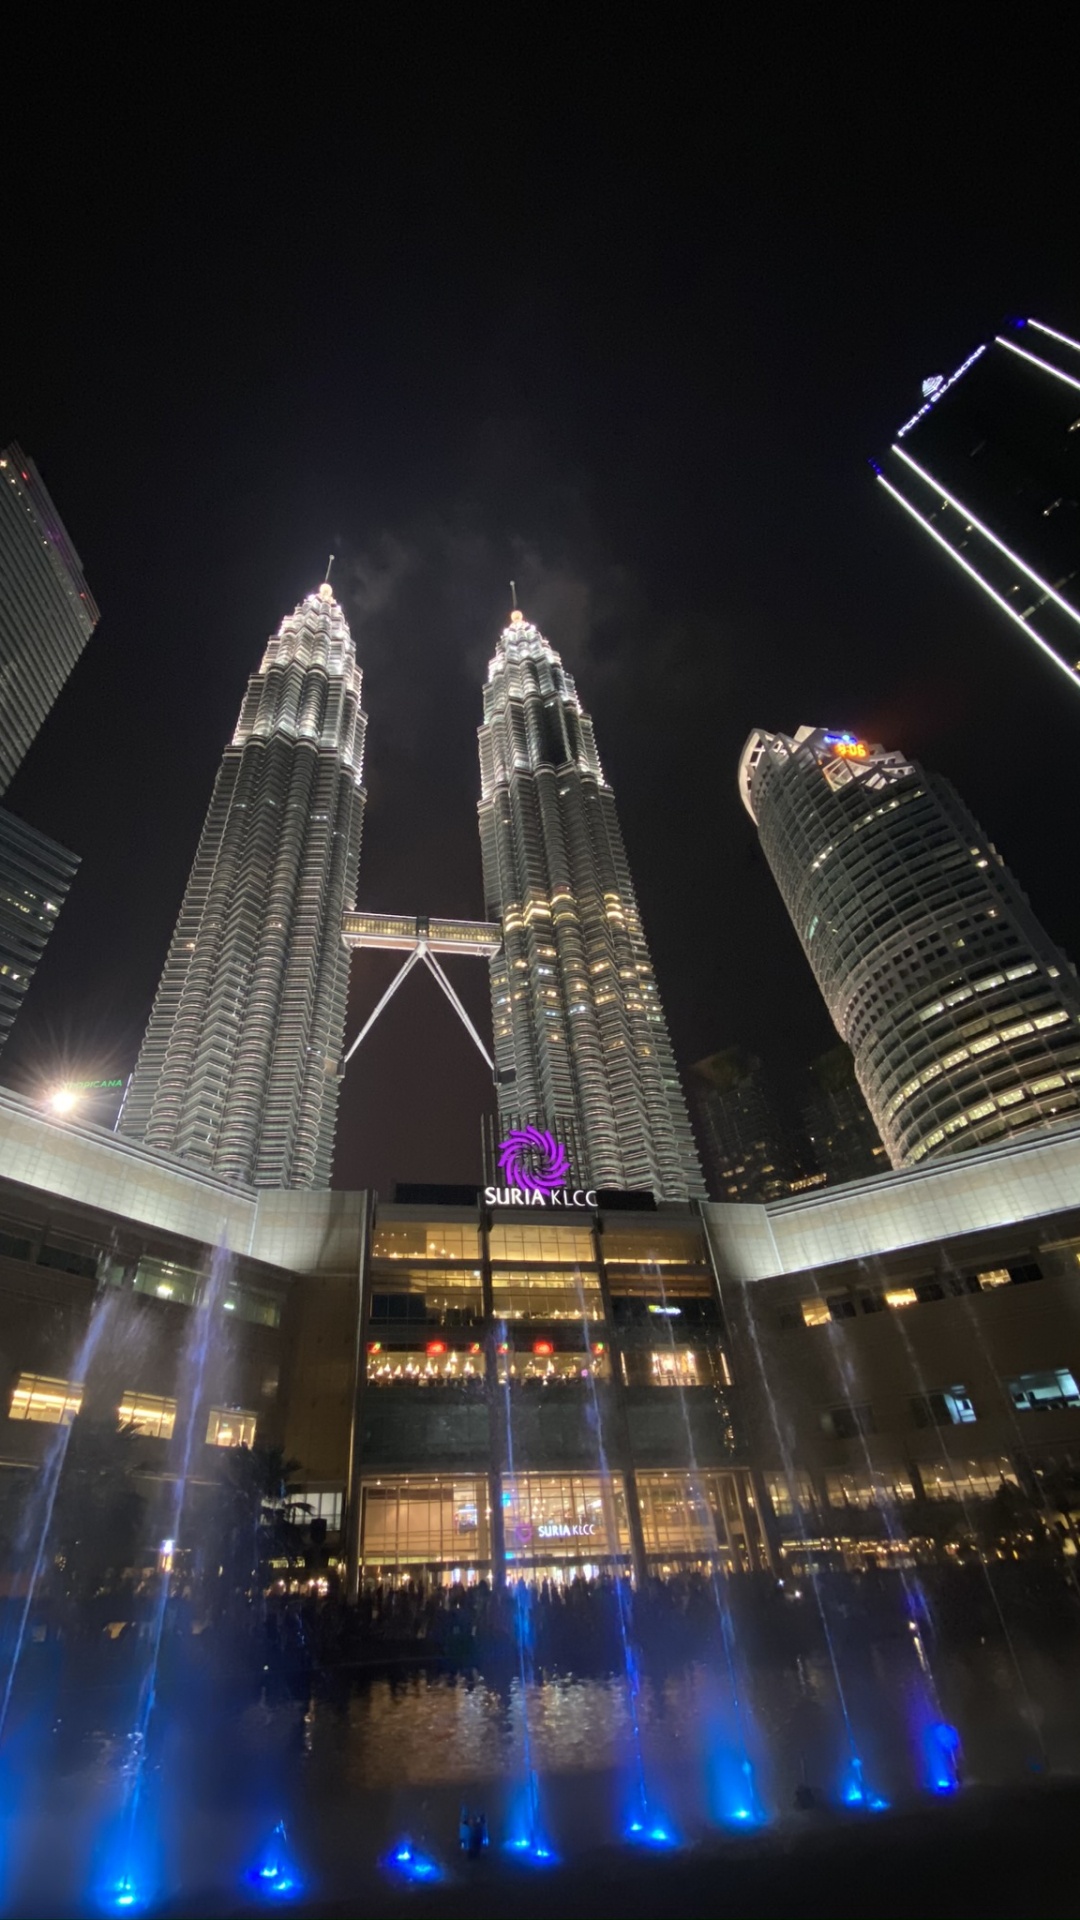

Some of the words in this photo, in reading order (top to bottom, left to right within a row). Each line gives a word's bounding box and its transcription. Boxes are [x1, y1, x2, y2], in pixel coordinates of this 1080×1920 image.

[484, 1187, 546, 1206] SURIA
[550, 1189, 599, 1207] KLCC
[538, 1525, 571, 1537] SURIA
[572, 1524, 596, 1535] KLCC
